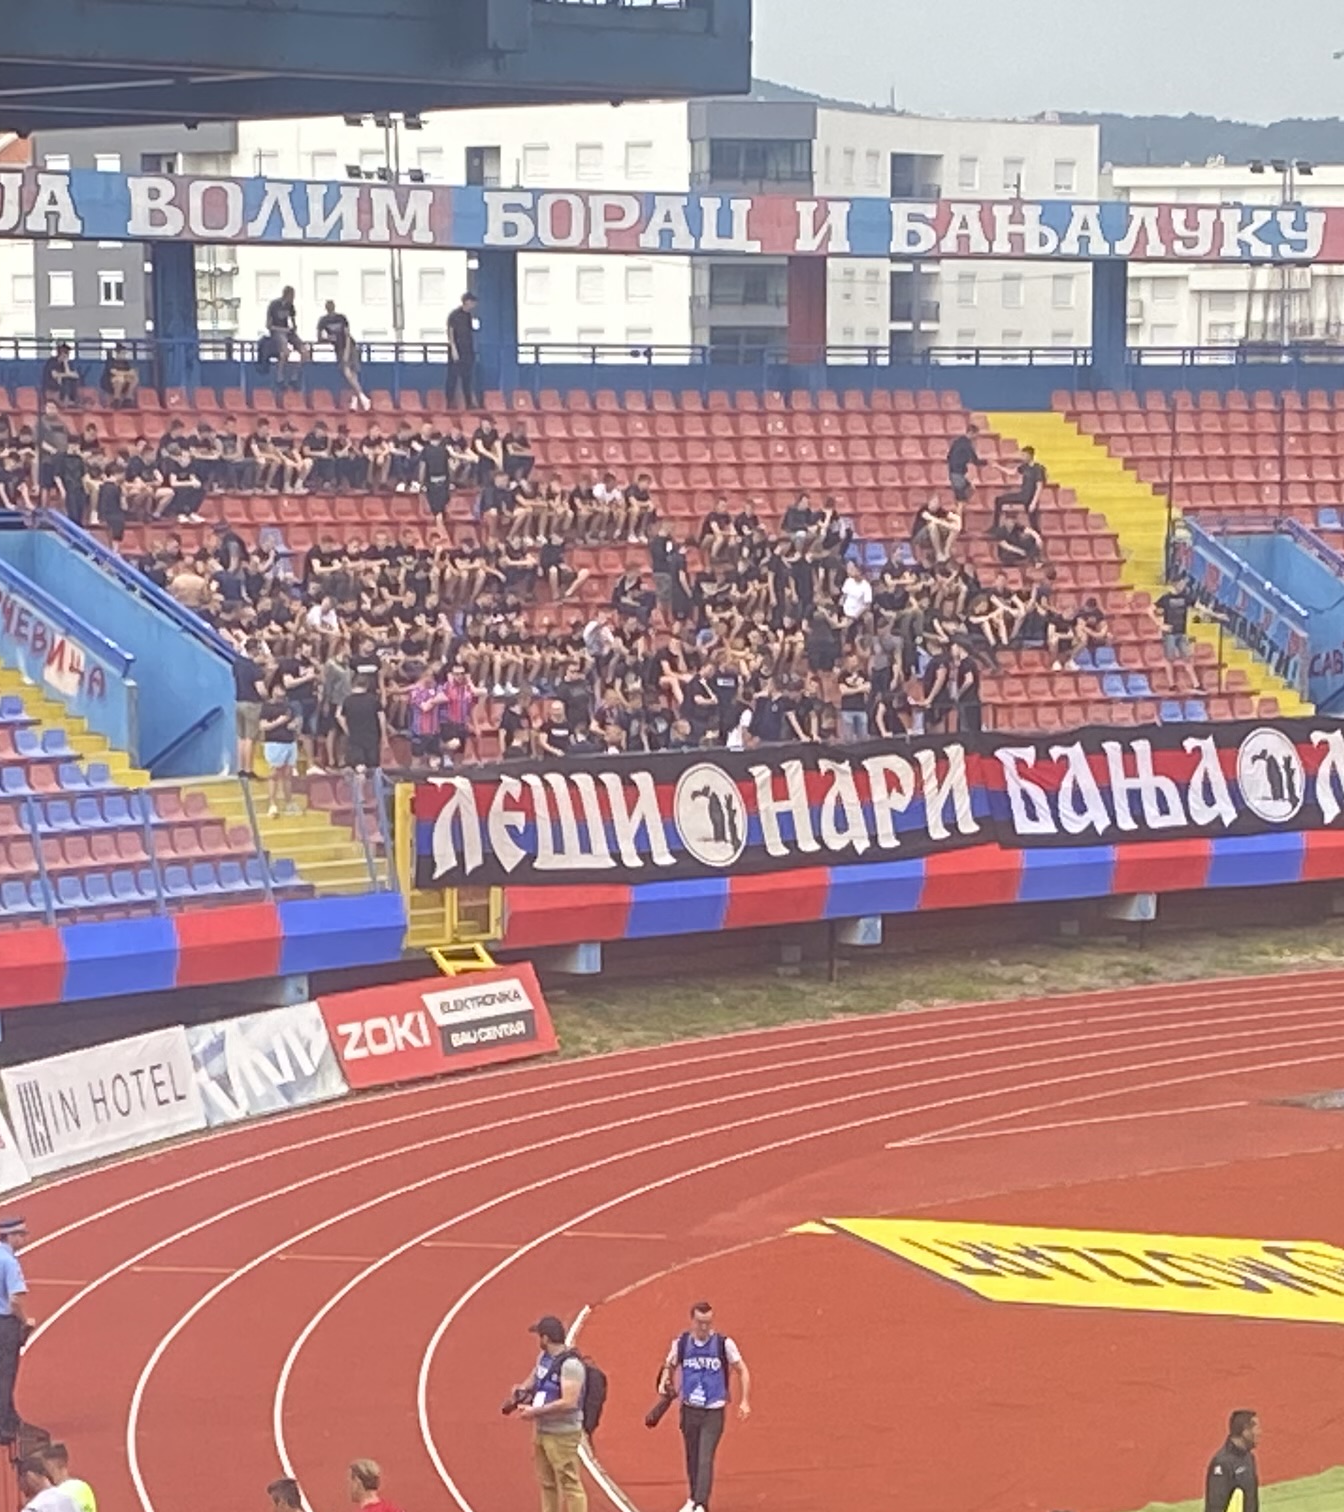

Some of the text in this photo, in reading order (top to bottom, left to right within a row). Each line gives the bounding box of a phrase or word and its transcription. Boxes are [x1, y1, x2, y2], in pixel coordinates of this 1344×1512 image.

[126, 176, 436, 244] ВОЛИМ
[483, 191, 762, 252] БОРАЦ
[795, 201, 851, 252] И
[890, 201, 1327, 258] БАЊАЛУКУ
[336, 1010, 431, 1060] ZOKI
[48, 1088, 81, 1136] IN
[92, 1062, 187, 1123] HOTEL
